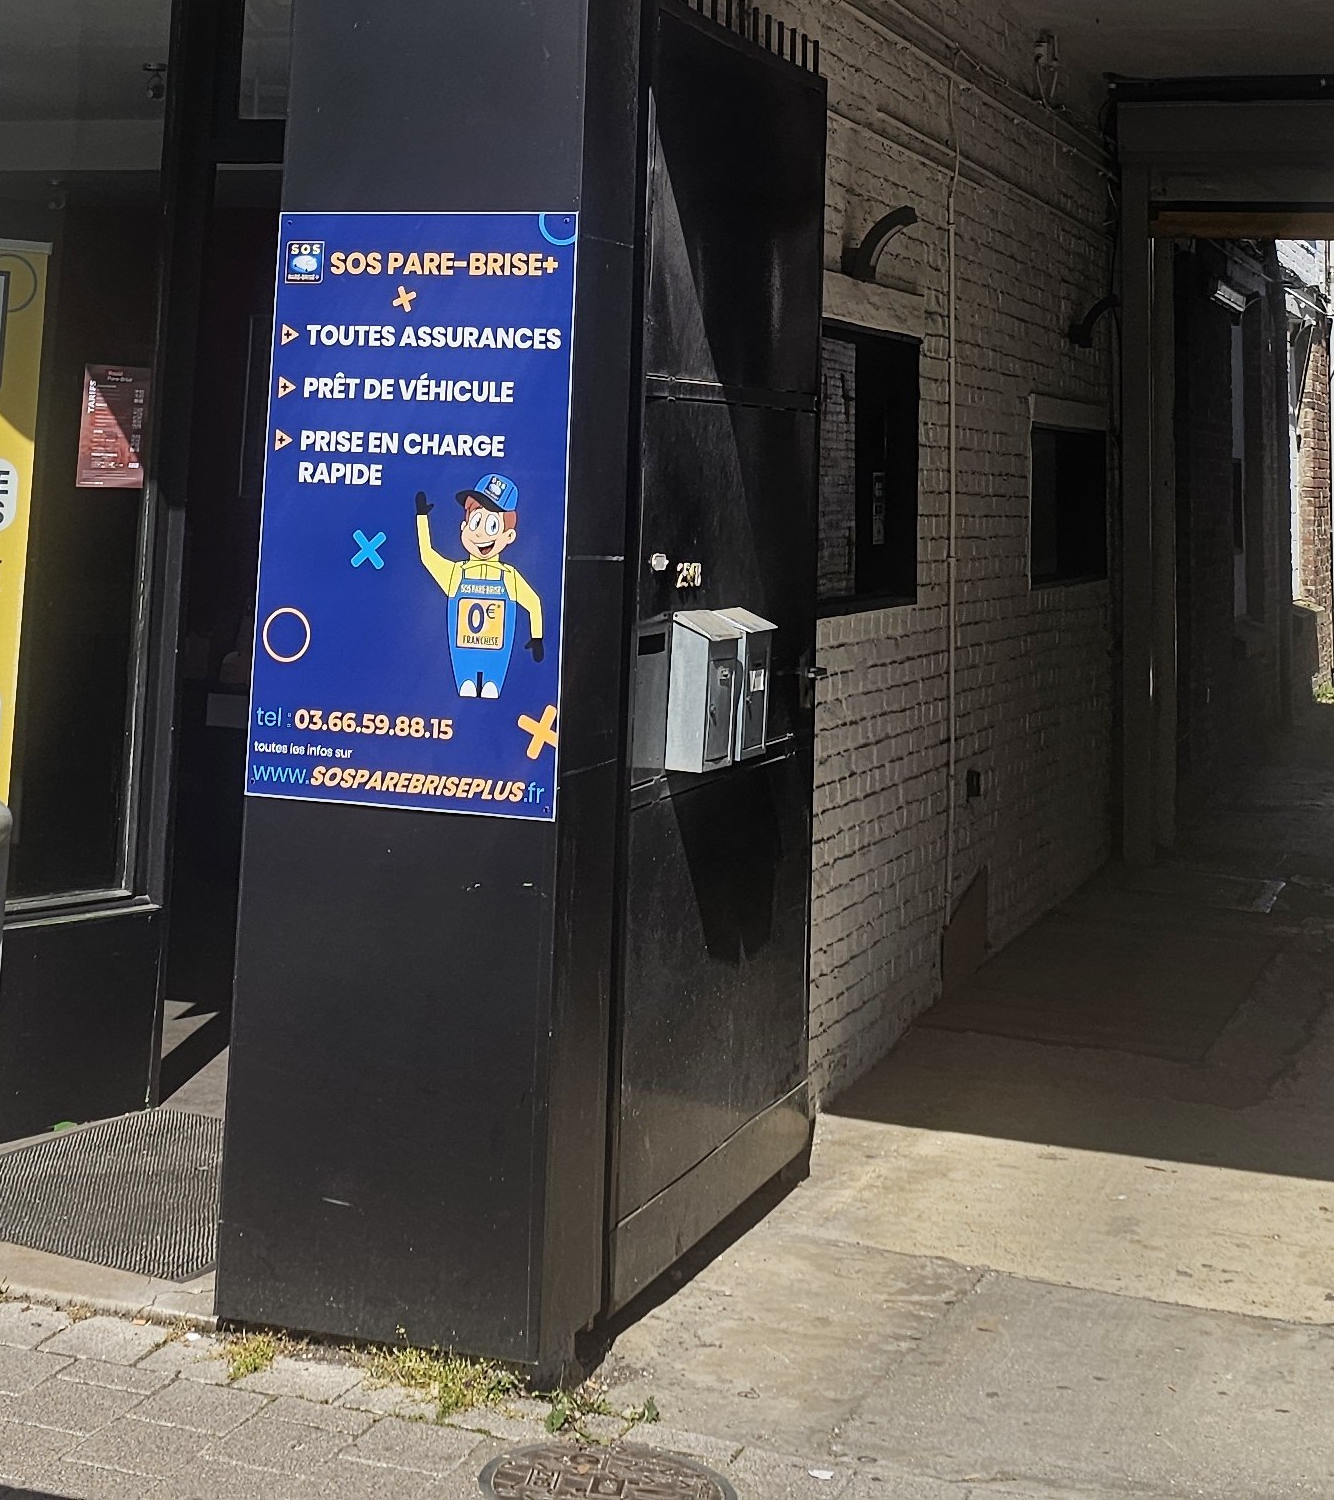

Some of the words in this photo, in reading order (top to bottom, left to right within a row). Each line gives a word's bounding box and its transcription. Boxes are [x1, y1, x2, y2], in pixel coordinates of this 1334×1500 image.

[290, 243, 321, 255] SOS
[329, 251, 382, 275] SOS
[387, 252, 559, 276] PARE-BRISE+
[306, 324, 396, 347] TOUTES
[399, 325, 562, 350] ASSURANCES
[87, 379, 97, 414] TARIFS
[303, 372, 361, 400] PRÊT
[364, 378, 394, 401] DE
[398, 372, 515, 404] VÉHICULE
[300, 430, 364, 454] PRISE
[368, 431, 399, 455] EN
[403, 431, 505, 458] CHARGE
[298, 461, 383, 486] RAPIDE
[294, 708, 454, 740] 03.66.59.88.15
[254, 740, 288, 754] toutes
[289, 742, 306, 756] les
[307, 743, 334, 758] infos
[334, 747, 354, 759] sur
[252, 764, 545, 804] www.SOSPAREBRISEPLUS.fr
